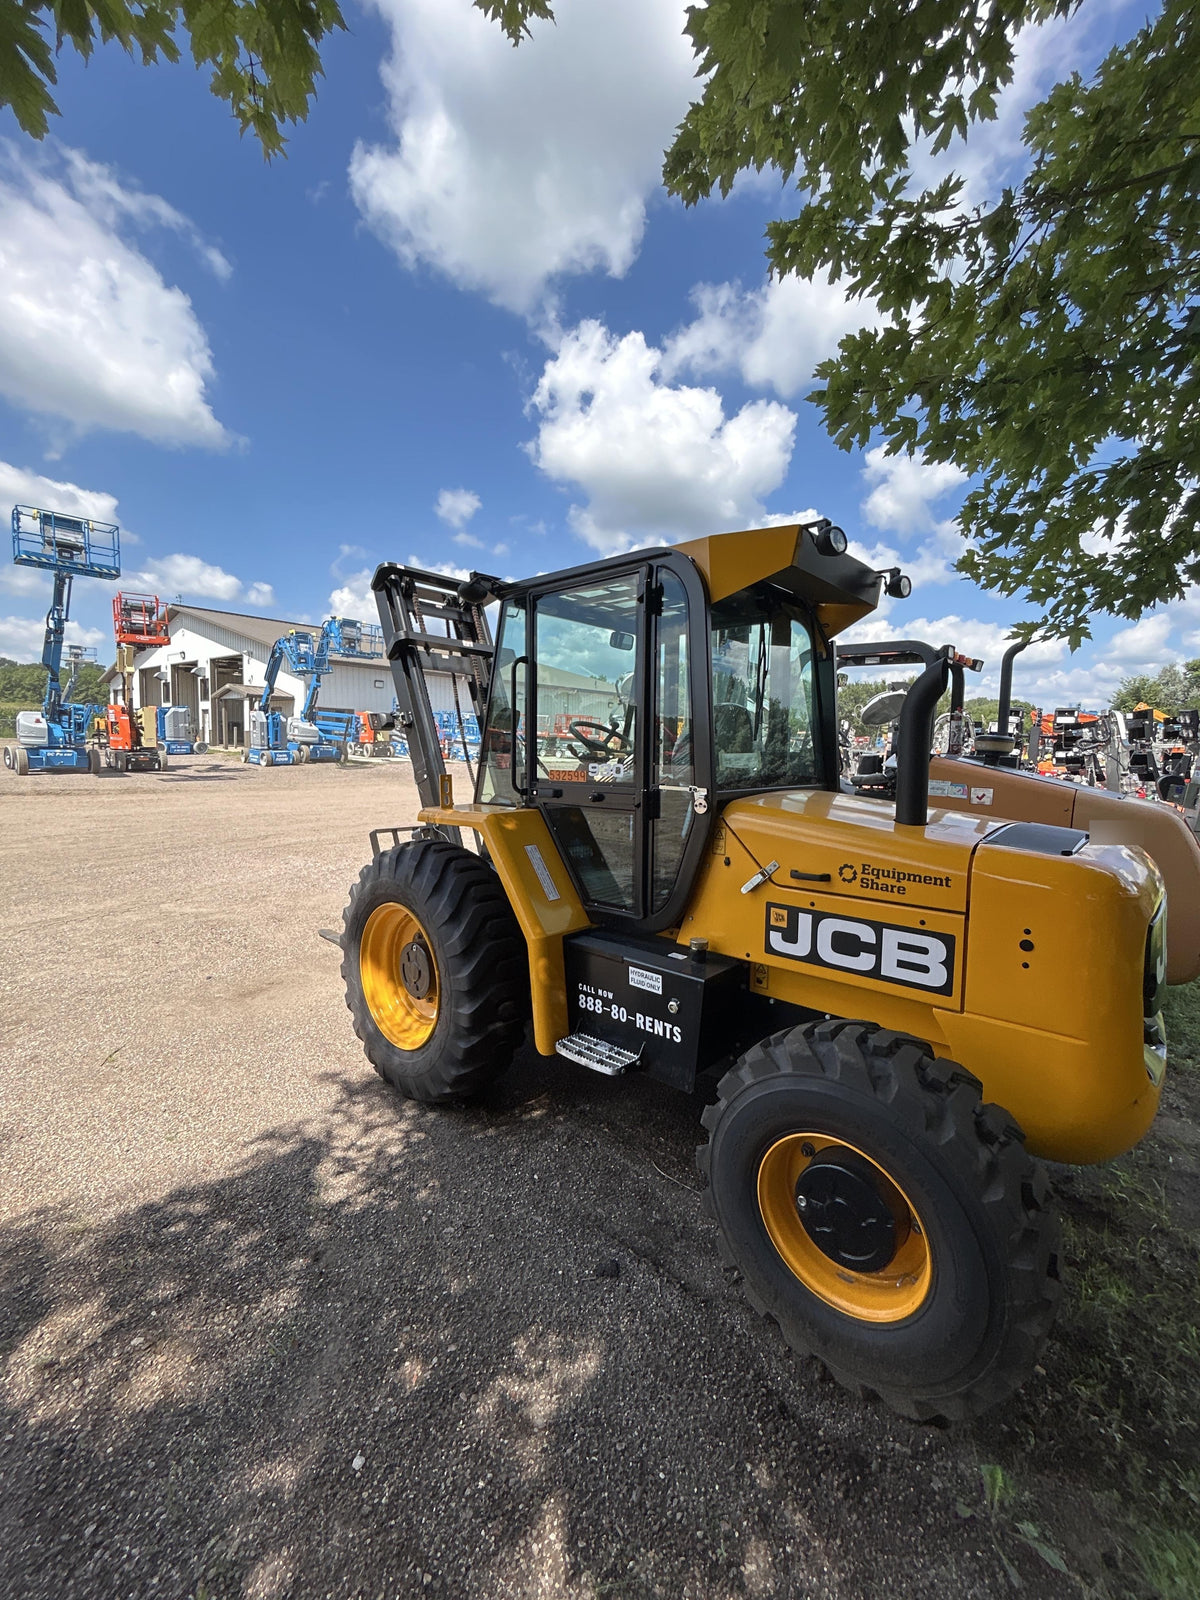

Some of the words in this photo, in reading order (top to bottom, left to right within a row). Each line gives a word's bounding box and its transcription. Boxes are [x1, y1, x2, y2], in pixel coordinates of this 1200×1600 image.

[549, 770, 586, 781] 532599
[861, 863, 952, 888] Equipment
[860, 877, 906, 895] Share
[769, 912, 948, 987] JCB
[630, 969, 661, 983] HYDRAULIC
[630, 978, 646, 987] FLUID
[646, 982, 661, 991] ONLY
[578, 983, 596, 994] CALL
[598, 989, 614, 1000] NOW
[578, 994, 682, 1043] 888-80-RENTS
